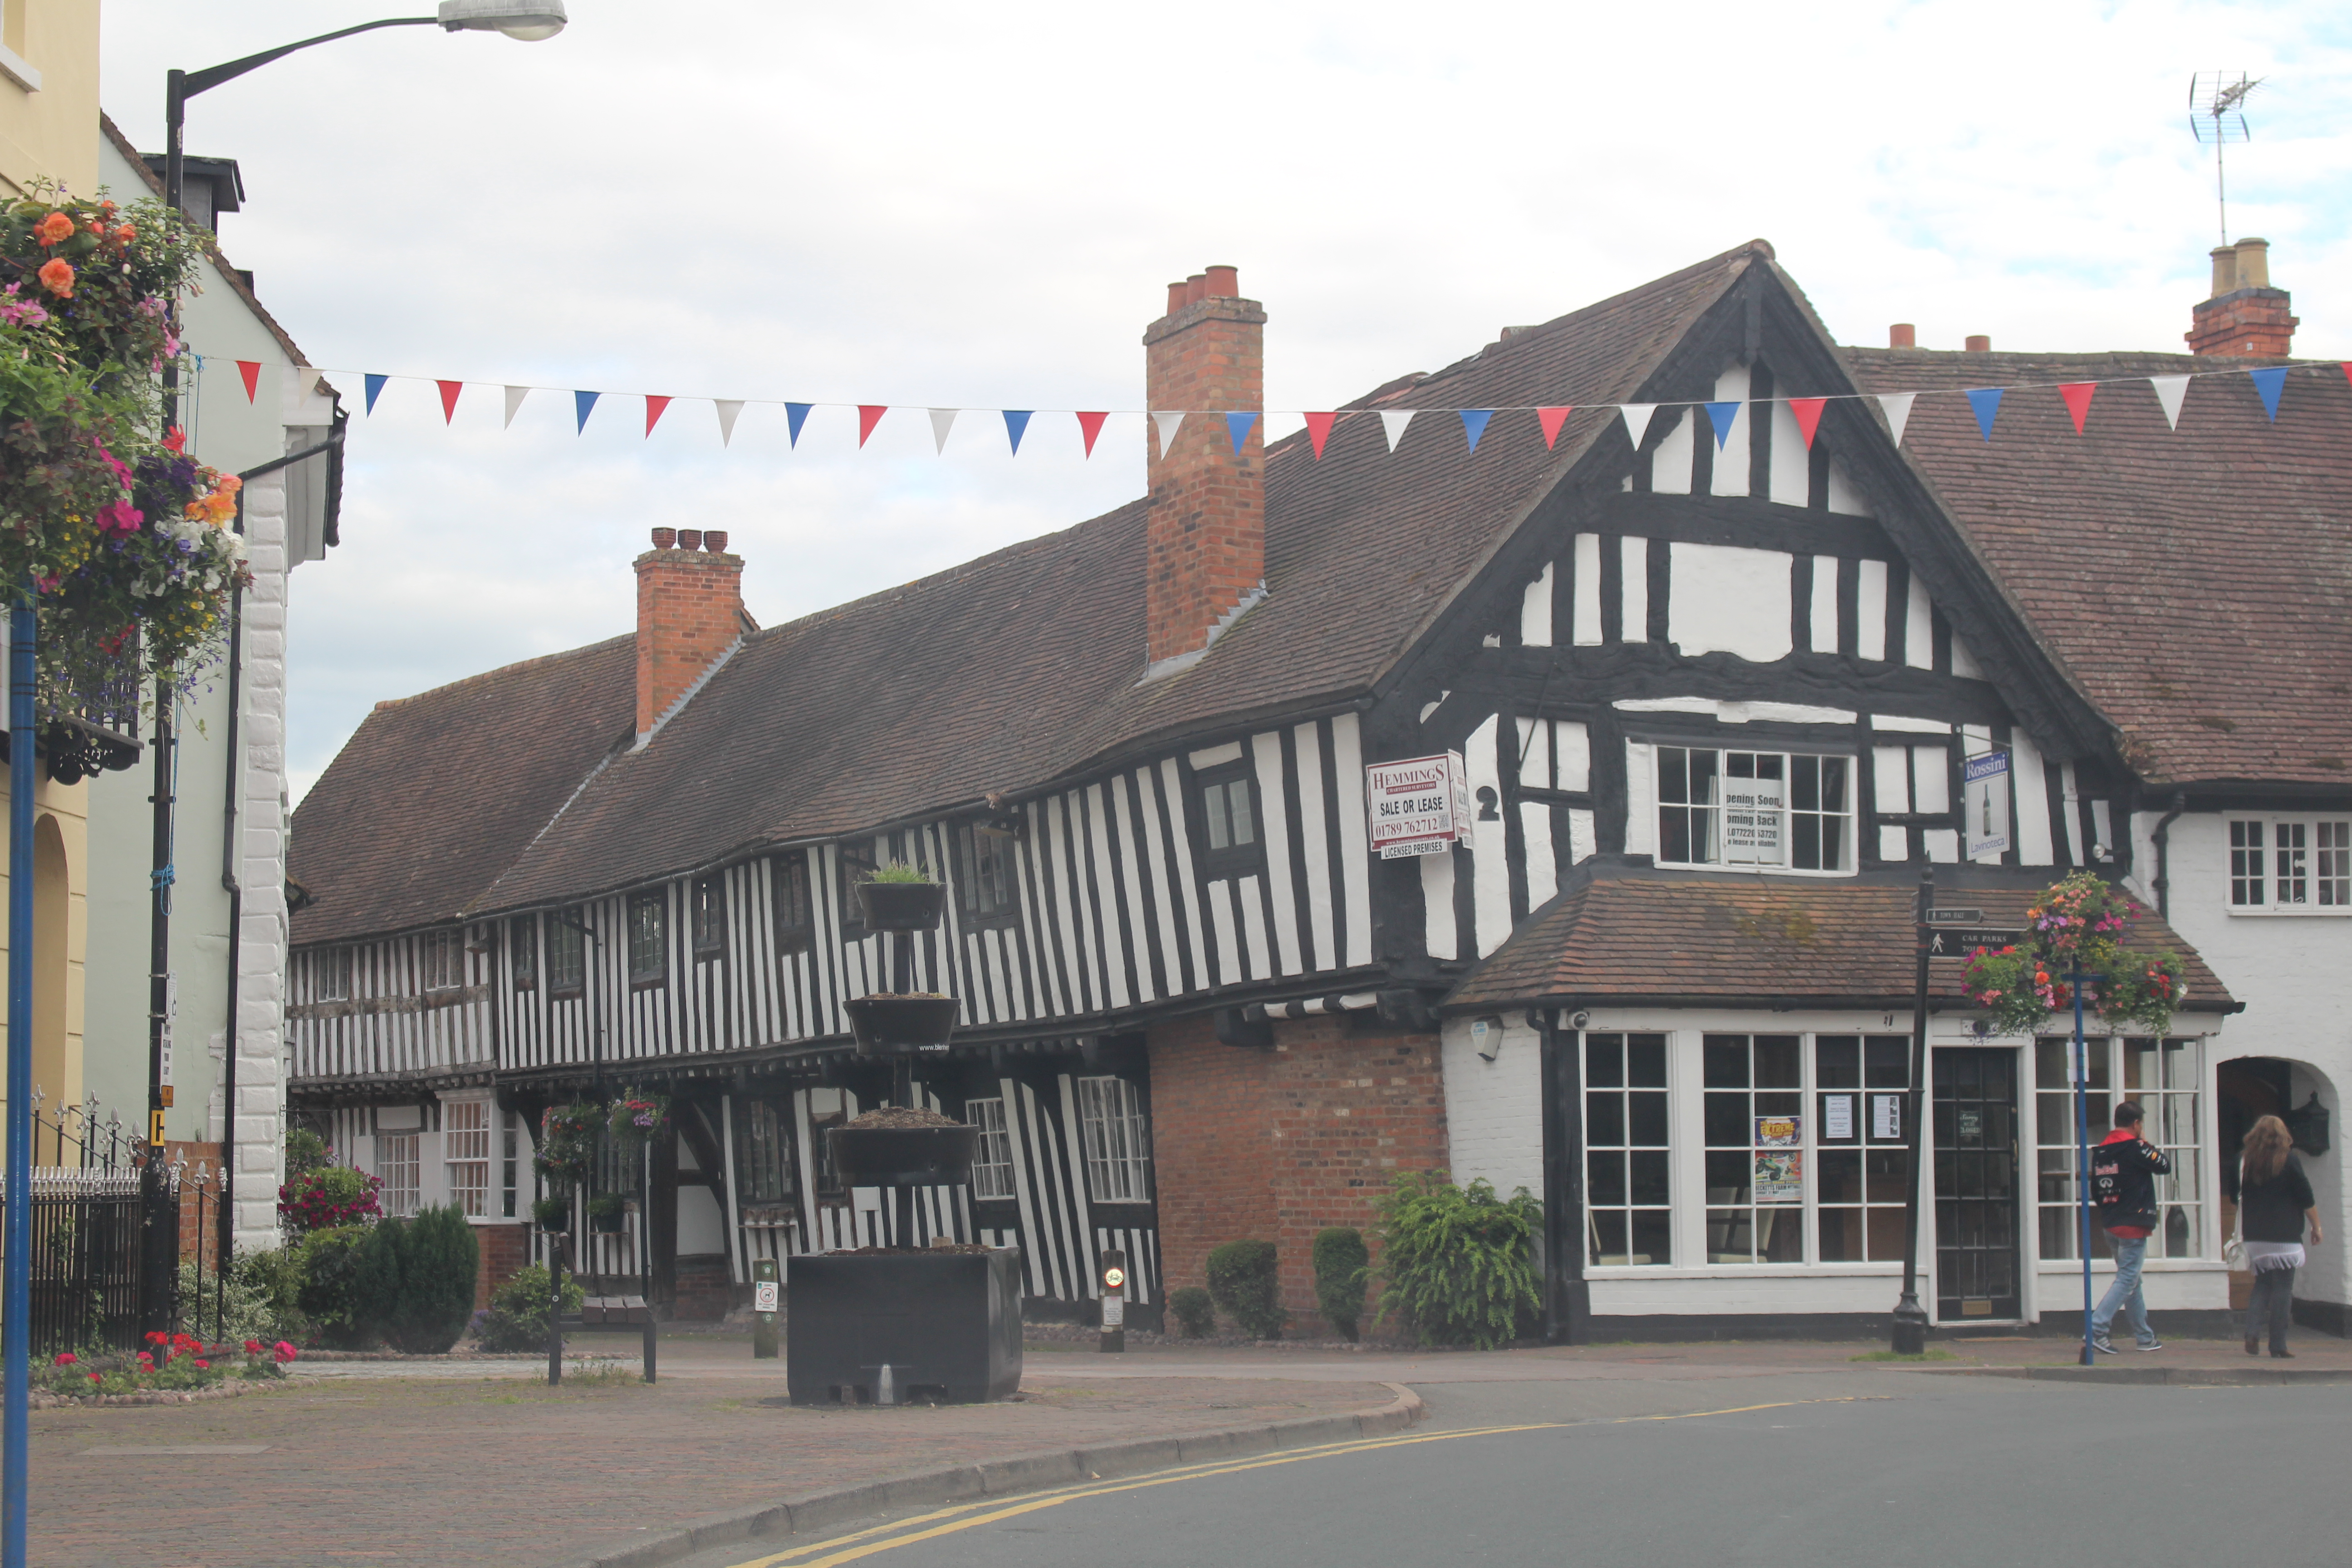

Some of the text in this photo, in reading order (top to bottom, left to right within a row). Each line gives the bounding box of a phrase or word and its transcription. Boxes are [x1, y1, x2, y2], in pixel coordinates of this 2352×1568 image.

[1966, 754, 2006, 779] Rossini
[1373, 764, 1445, 790] HEMMINGS
[1381, 797, 1443, 816] SALE OR LEASE
[1727, 794, 1779, 806] pening Soon
[1376, 818, 1438, 838] 01789 762712
[1727, 814, 1777, 826] oming Back
[1385, 842, 1442, 858] LICENSED PREMISES
[1971, 838, 2004, 853] Lavinoteca
[1760, 1122, 1795, 1136] EXTREME
